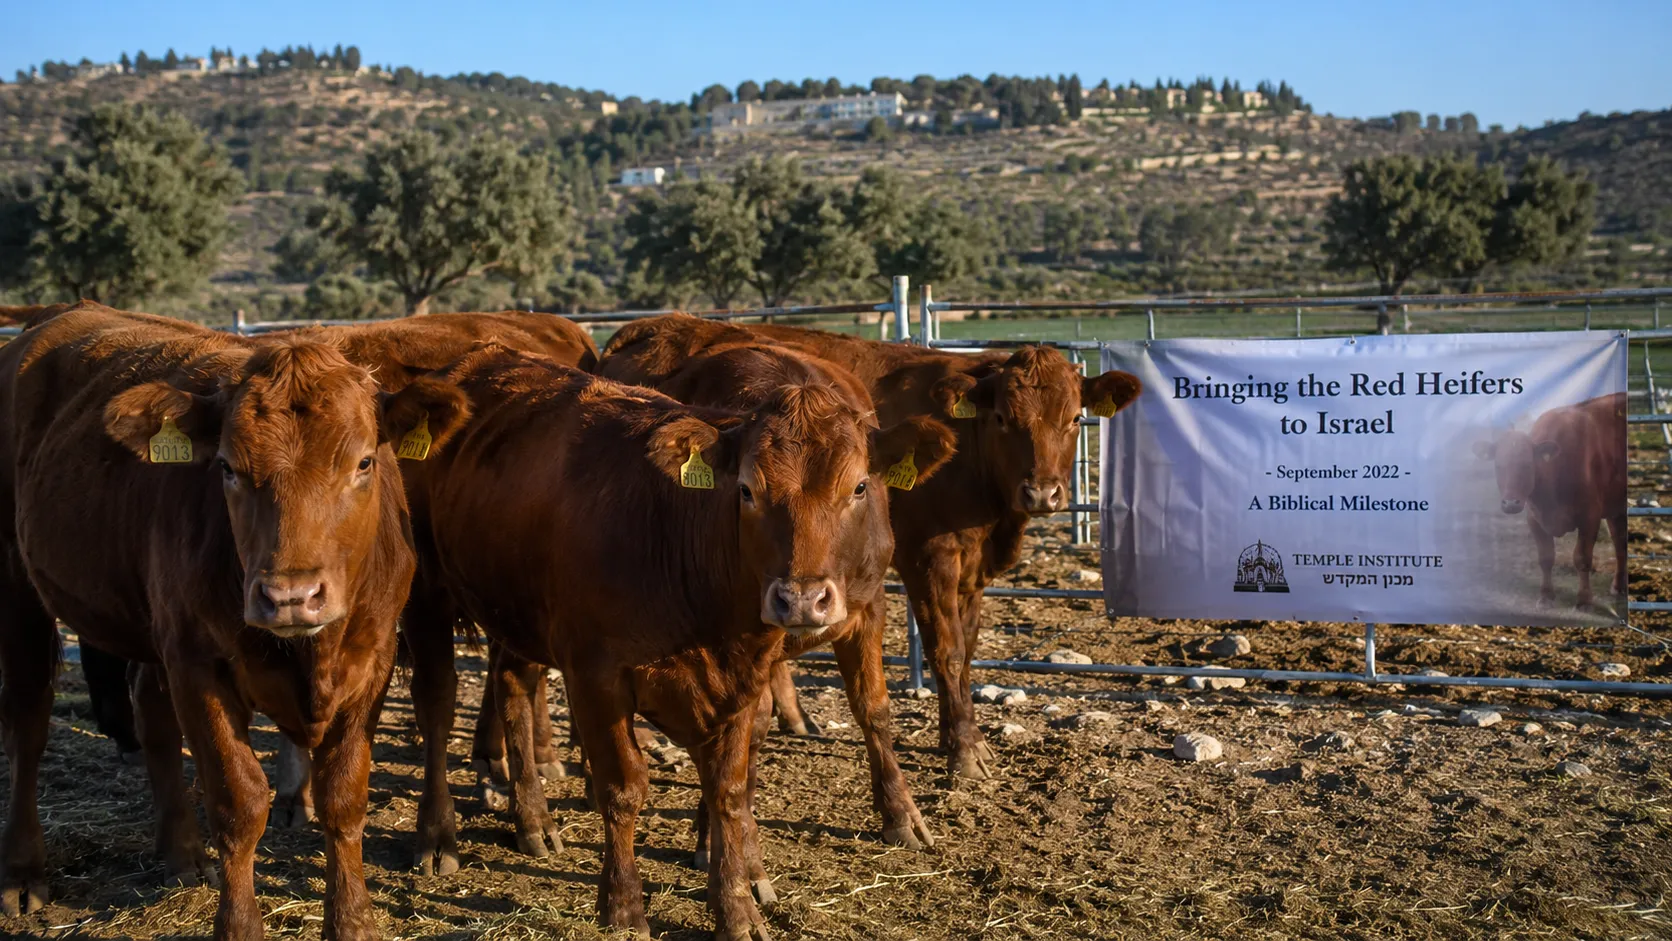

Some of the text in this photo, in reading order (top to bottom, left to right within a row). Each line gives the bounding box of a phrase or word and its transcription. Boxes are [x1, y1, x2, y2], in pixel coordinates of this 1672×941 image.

[1172, 370, 1524, 405] Bringing the Red Heifers
[1279, 409, 1395, 436] to Israel
[152, 444, 190, 461] 9013
[1276, 464, 1359, 483] September
[1362, 464, 1400, 479] 2022
[1248, 494, 1429, 512] A Biblical Milestone
[1292, 553, 1443, 568] TEMPLE INSTITUTE
[1322, 573, 1414, 589] מכון המקדש
